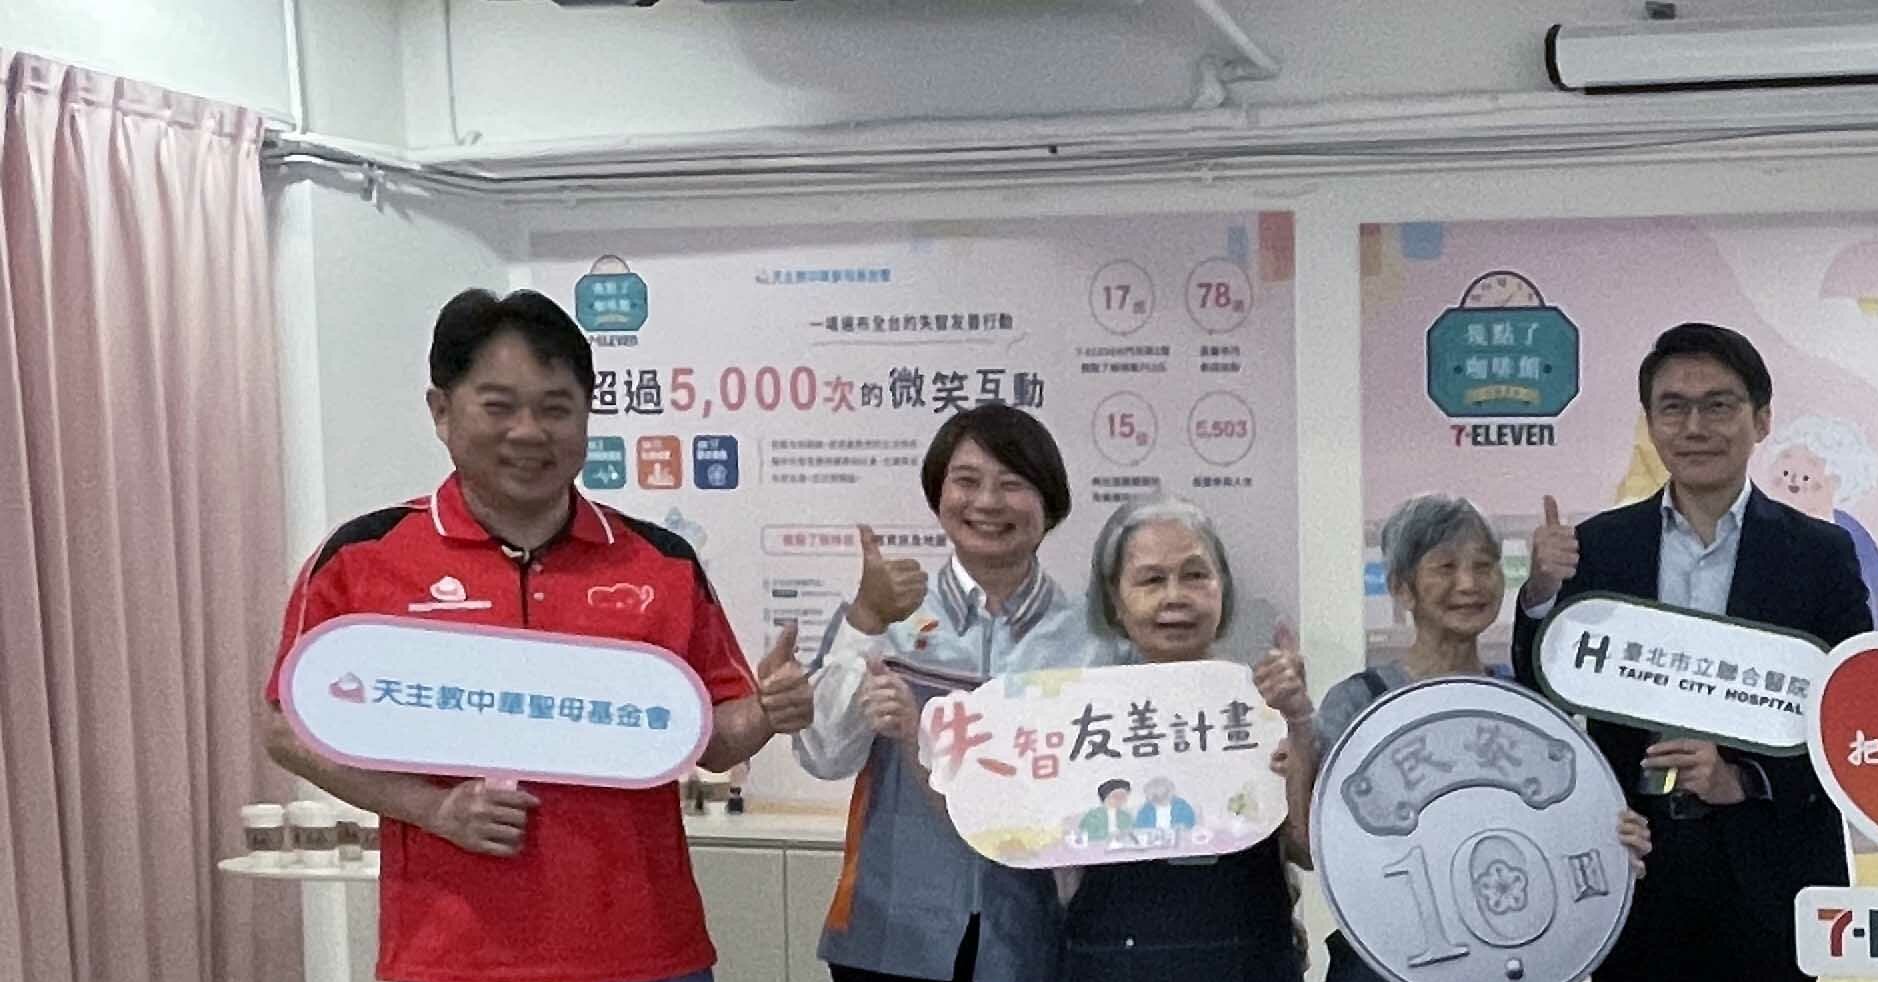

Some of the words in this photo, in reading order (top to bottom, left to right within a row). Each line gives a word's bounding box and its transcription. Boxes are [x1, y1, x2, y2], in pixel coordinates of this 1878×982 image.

[1574, 630, 1611, 673] H
[372, 676, 672, 731] 天主教中華聖母基金會
[1618, 665, 1670, 687] TAIPEI
[1678, 678, 1717, 695] CITY
[1724, 688, 1804, 716] HOSPITAL
[929, 700, 1260, 781] 失智友善計畫
